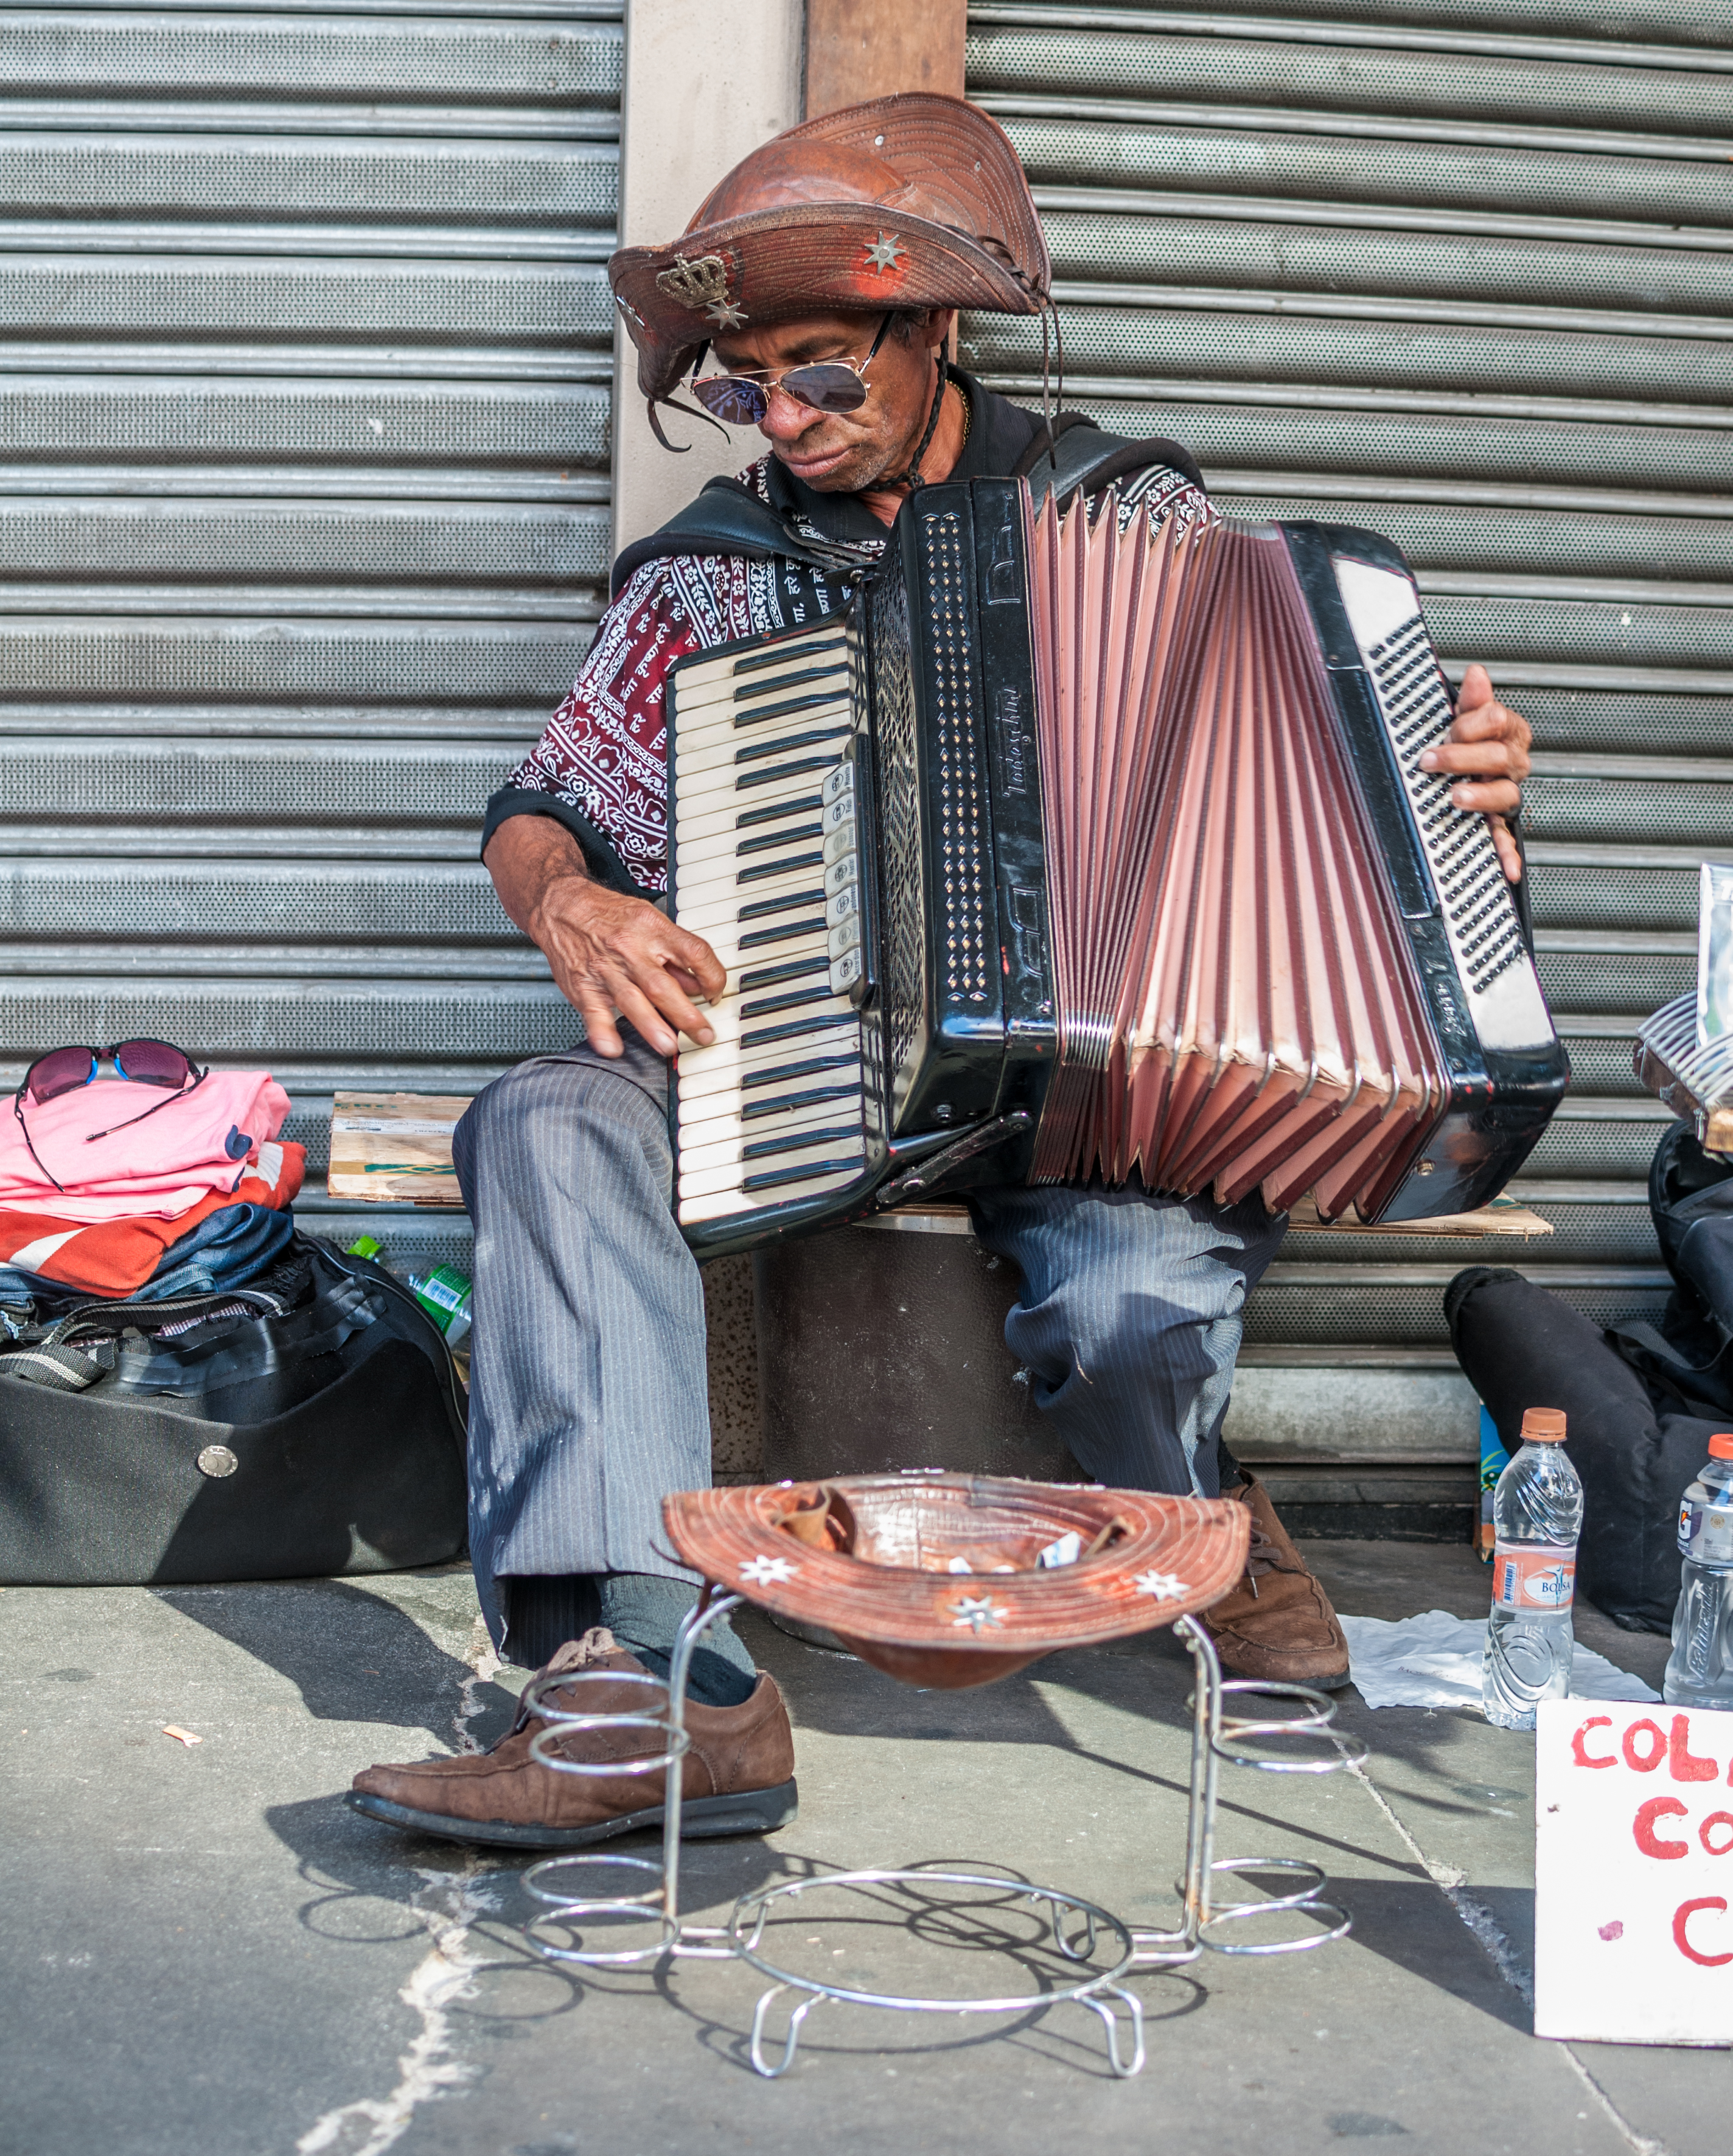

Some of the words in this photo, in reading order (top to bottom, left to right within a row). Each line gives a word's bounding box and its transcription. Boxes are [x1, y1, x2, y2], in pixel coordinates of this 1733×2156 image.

[997, 688, 1027, 798] Todeschini
[1541, 1581, 1571, 1593] BOLSA
[1571, 1714, 1733, 1787] COL
